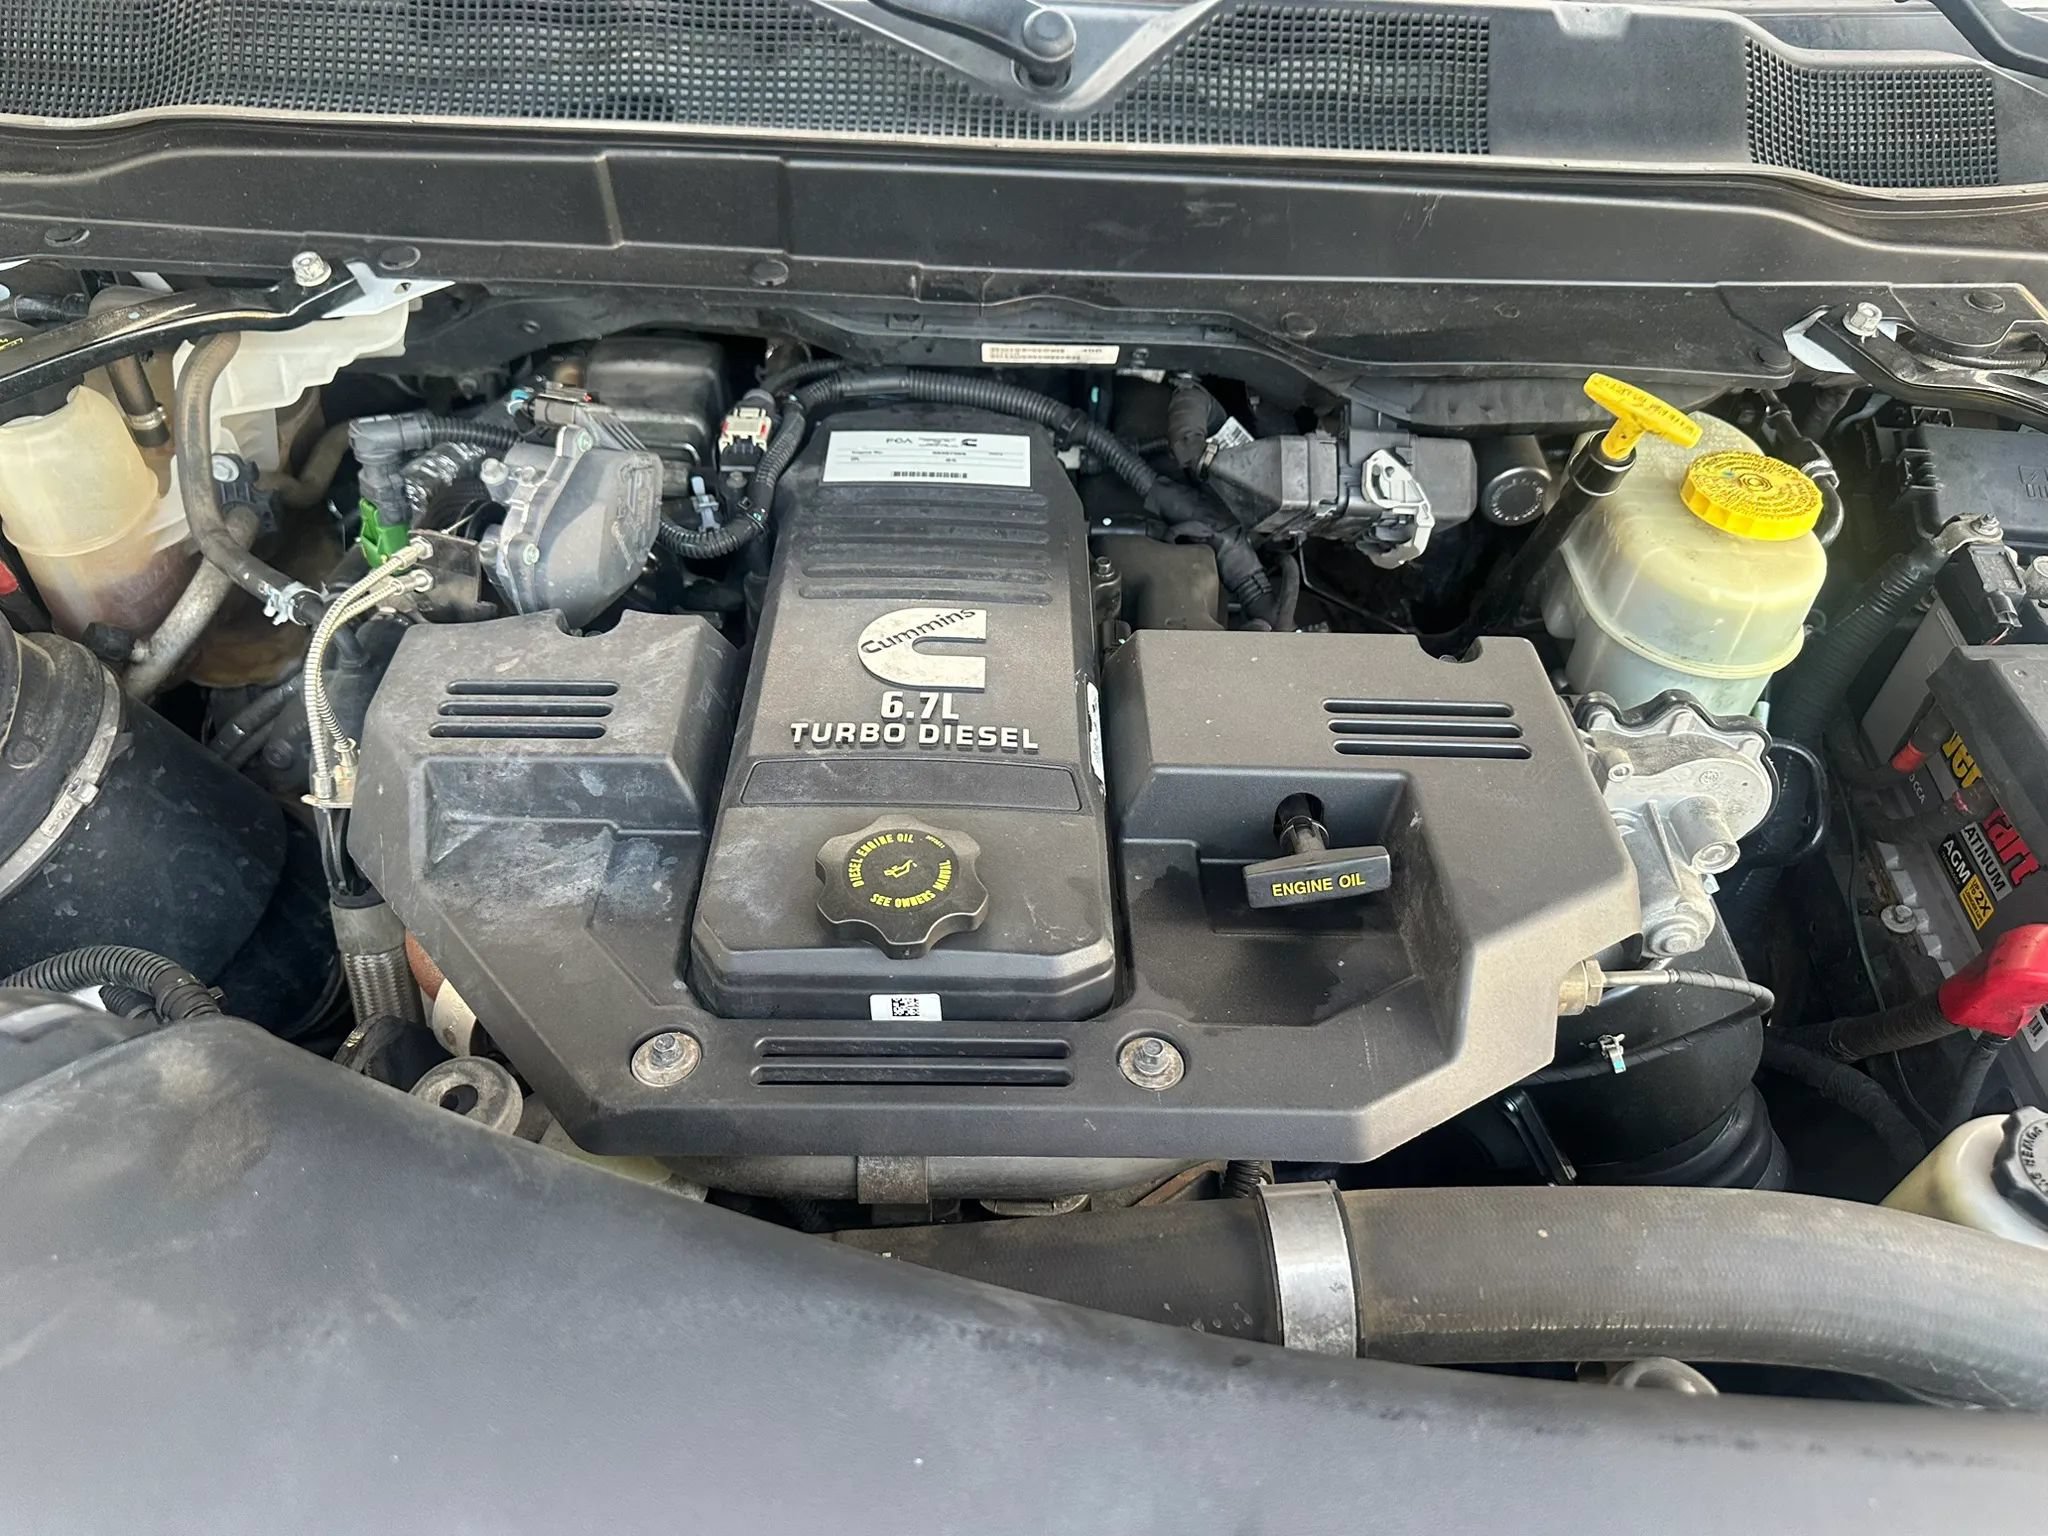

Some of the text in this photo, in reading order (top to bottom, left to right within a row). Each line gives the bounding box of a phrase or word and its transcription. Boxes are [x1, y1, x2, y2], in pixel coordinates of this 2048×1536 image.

[860, 608, 976, 654] Cummins
[880, 690, 960, 722] 6.7L
[790, 722, 1040, 751] TURBO DIESEL
[1912, 780, 1925, 804] CCA
[856, 834, 894, 858] ENGINE
[897, 833, 914, 843] OIL
[848, 856, 865, 888] DIESEL
[1943, 840, 1971, 883] AGM
[1964, 826, 2006, 892] ATINUM
[870, 860, 952, 909] SEE OWNERS MANUAL
[1271, 872, 1366, 897] ENGINE OIL
[1969, 879, 1991, 917] UP TO 2X
